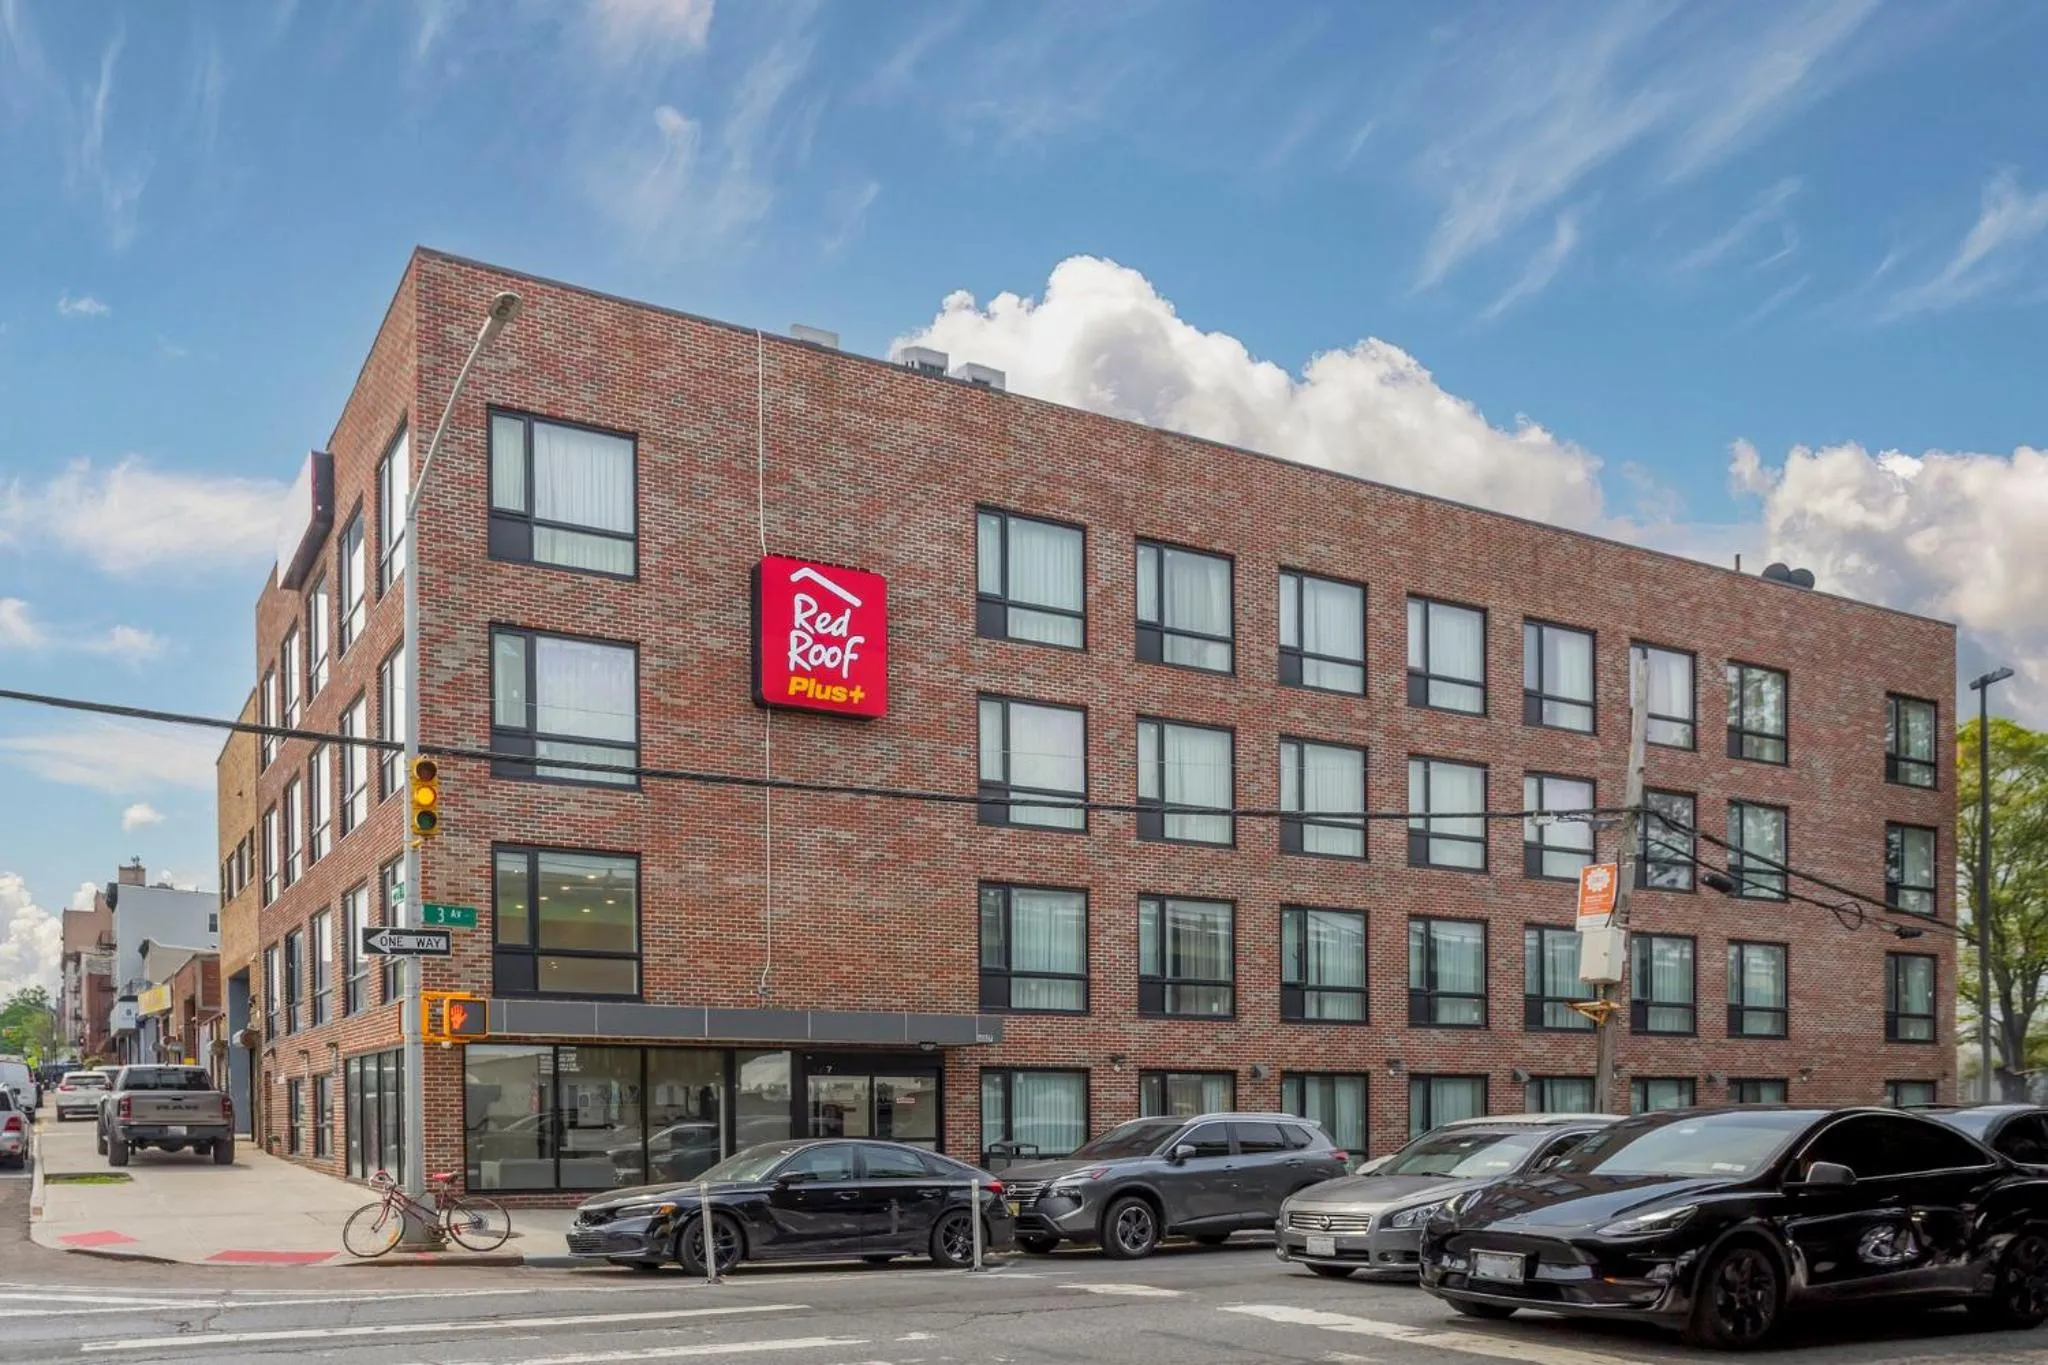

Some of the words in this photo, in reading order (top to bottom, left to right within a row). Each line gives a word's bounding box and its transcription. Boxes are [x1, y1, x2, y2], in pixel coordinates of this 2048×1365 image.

[794, 593, 851, 637] Red
[788, 630, 865, 679] Roof
[787, 676, 866, 704] Plus+
[437, 907, 445, 923] 3
[380, 935, 404, 947] ONE
[416, 936, 441, 948] WAY
